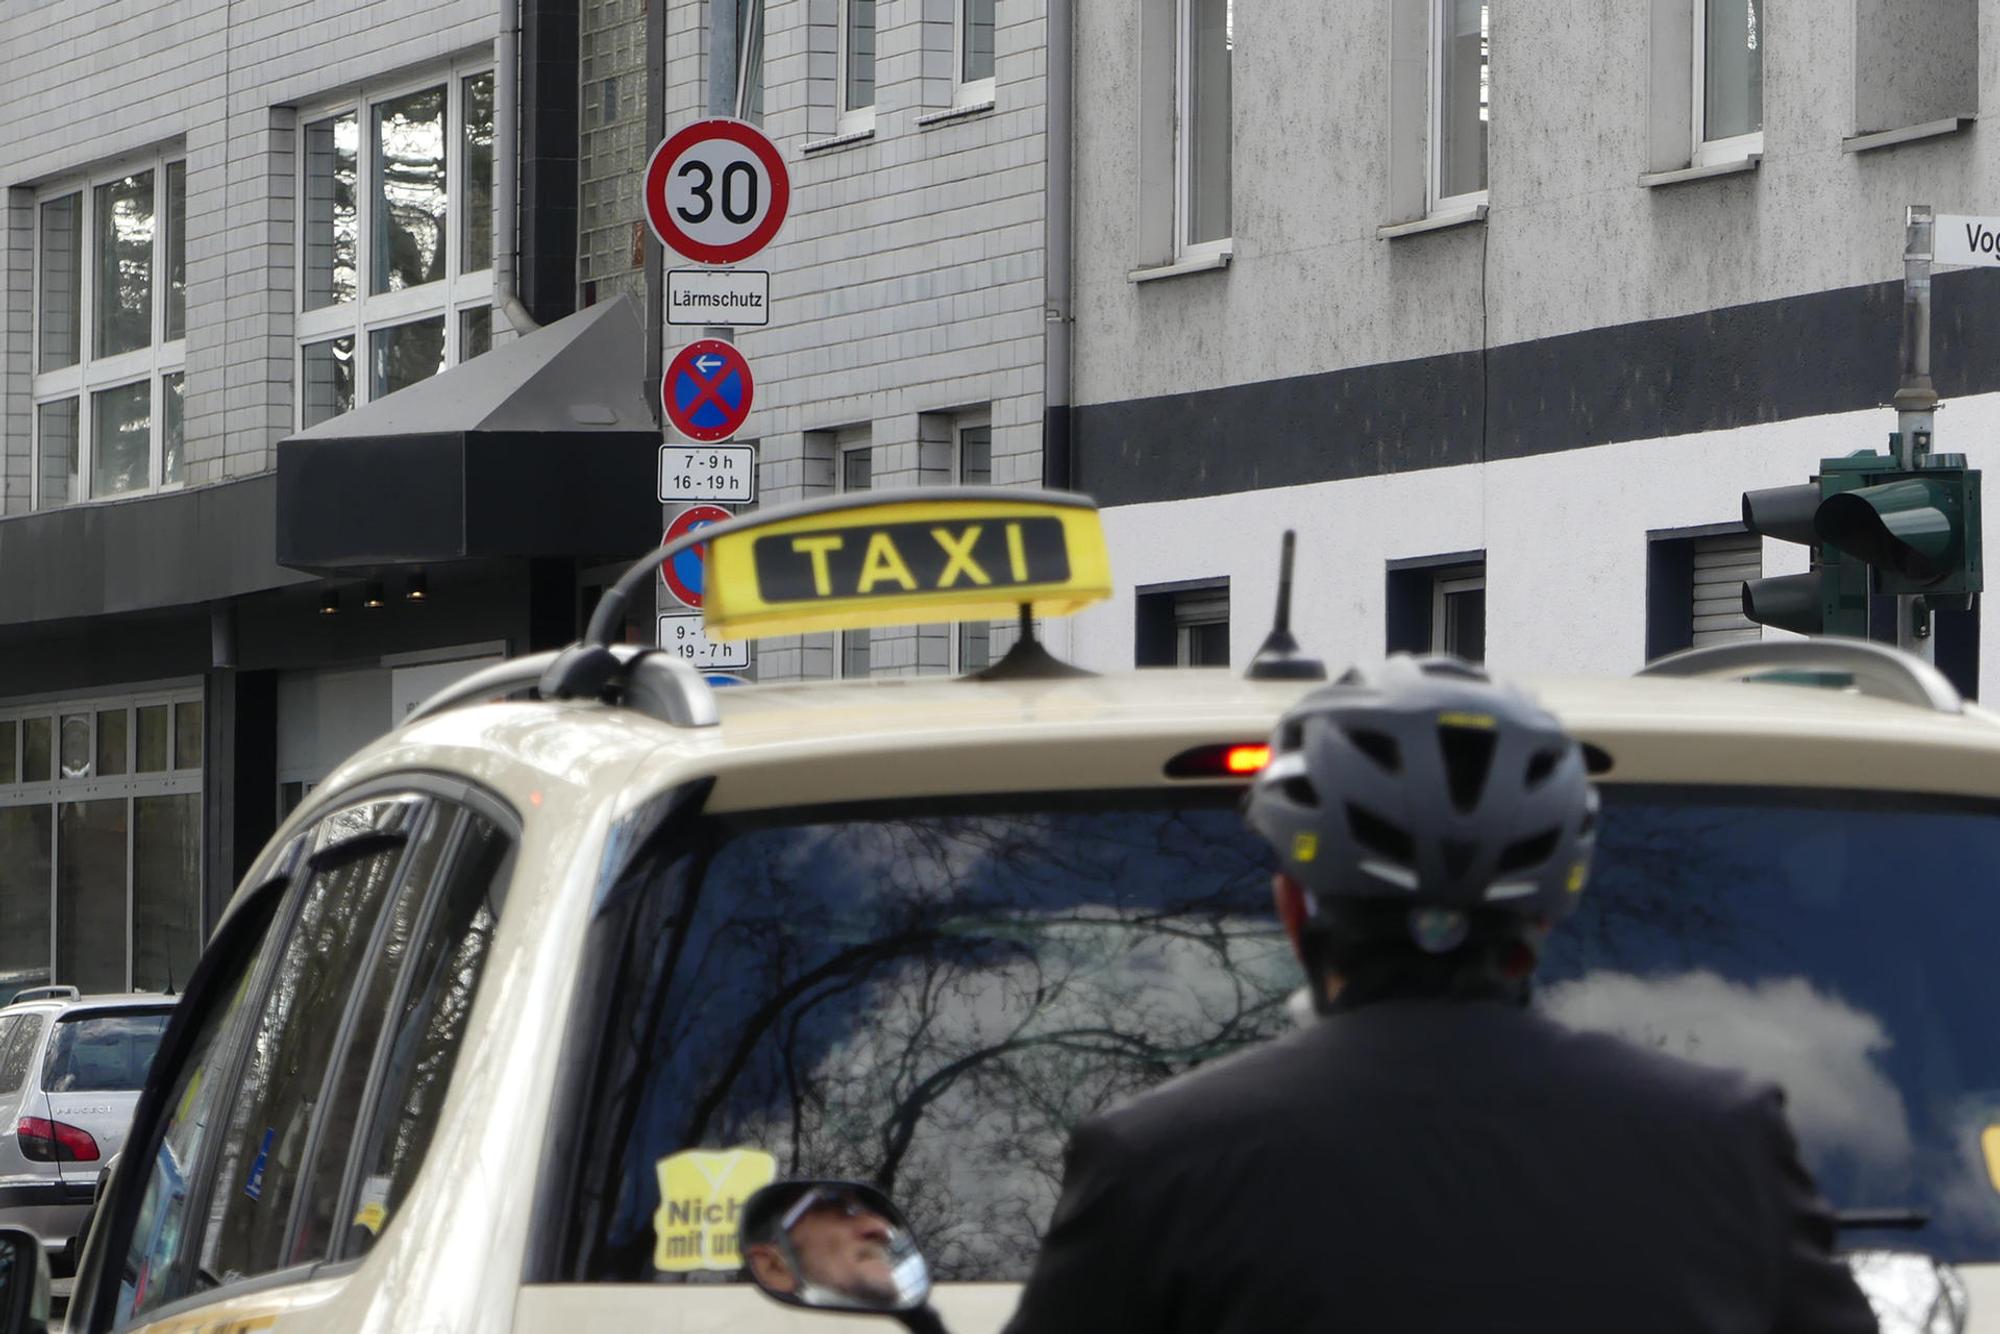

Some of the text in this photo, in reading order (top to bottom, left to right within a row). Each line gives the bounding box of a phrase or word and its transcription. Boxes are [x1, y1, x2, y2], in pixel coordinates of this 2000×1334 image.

[676, 160, 758, 225] 30
[673, 290, 762, 308] Lärmschutz
[685, 455, 694, 469] 7
[709, 455, 718, 469] 9
[723, 455, 733, 469] h
[673, 475, 691, 489] 16
[706, 475, 725, 489] 19
[729, 475, 739, 489] h
[791, 521, 1030, 597] TAXI
[676, 625, 685, 639] 9
[677, 644, 695, 658] 19
[709, 643, 718, 657] 7
[723, 643, 732, 657] h
[666, 1229, 703, 1259] mit
